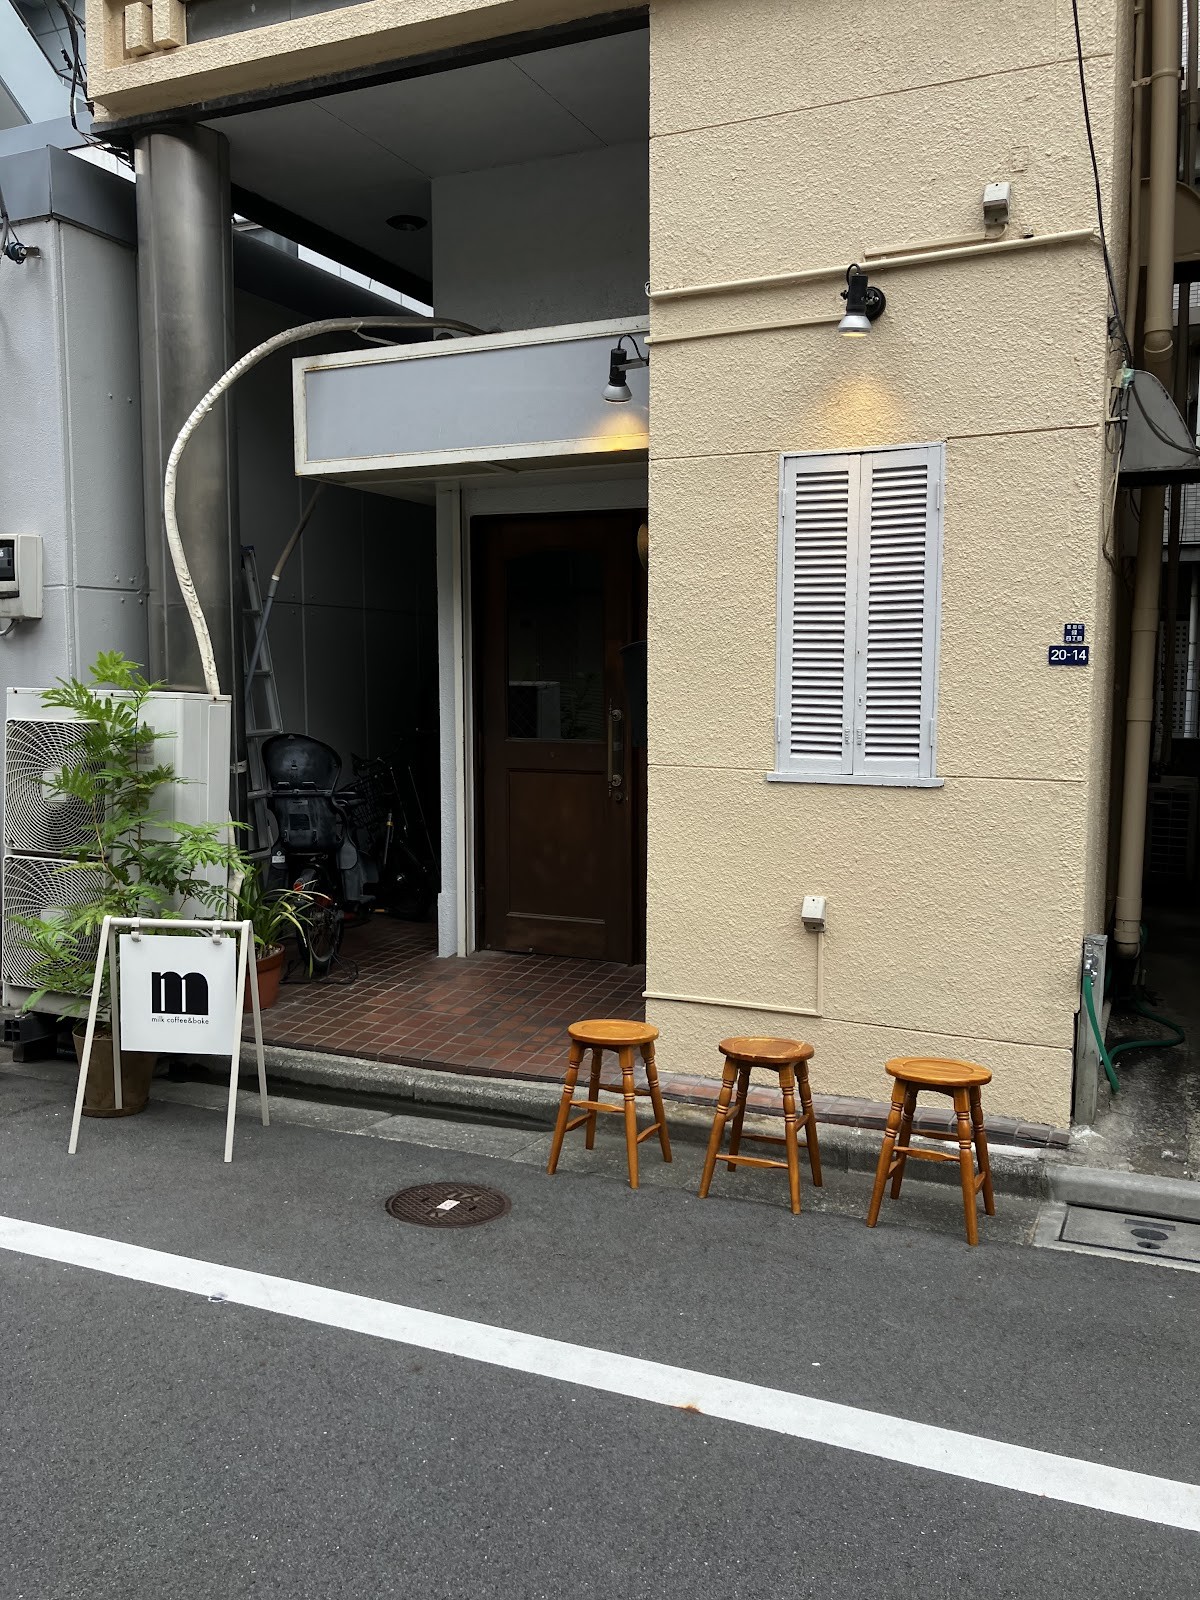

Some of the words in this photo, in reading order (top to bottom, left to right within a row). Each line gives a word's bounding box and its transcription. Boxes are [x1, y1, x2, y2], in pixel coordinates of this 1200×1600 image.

[1051, 649, 1087, 661] 20-14
[152, 971, 208, 1015] m
[167, 1016, 210, 1025] coffee&bake
